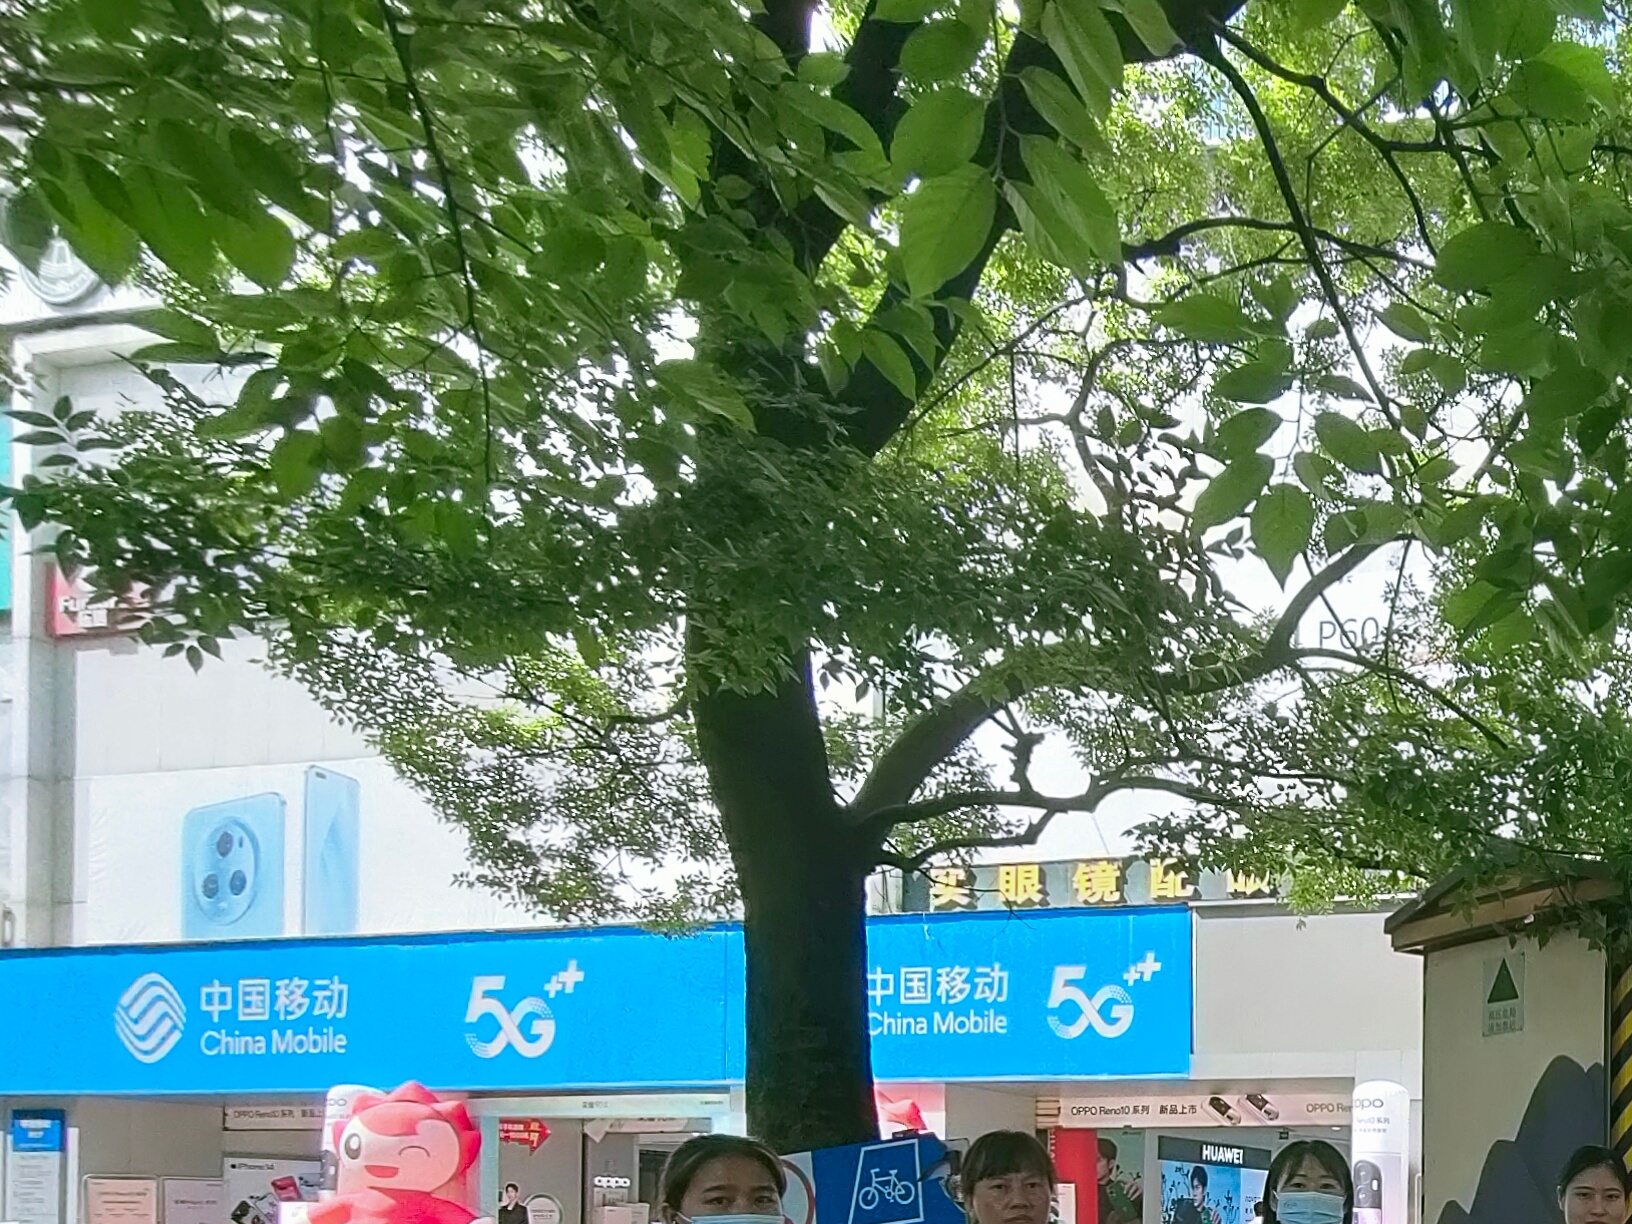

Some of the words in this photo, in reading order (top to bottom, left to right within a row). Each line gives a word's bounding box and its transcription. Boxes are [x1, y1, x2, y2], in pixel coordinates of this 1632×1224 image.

[1319, 617, 1379, 651] P60
[200, 975, 349, 1023] 中国移动
[867, 962, 1010, 1007] 中国移动
[868, 1011, 928, 1037] China
[932, 1007, 1008, 1036] Mobile
[201, 1029, 267, 1056] China
[271, 1028, 348, 1055] Mobile
[1071, 1106, 1098, 1116] OPPO
[1099, 1105, 1131, 1115] Reno10
[1132, 1104, 1150, 1115] 系列
[1159, 1104, 1198, 1115] 新品上市
[1306, 1103, 1335, 1113] OPPO
[1202, 1144, 1244, 1165] HUAWEI
